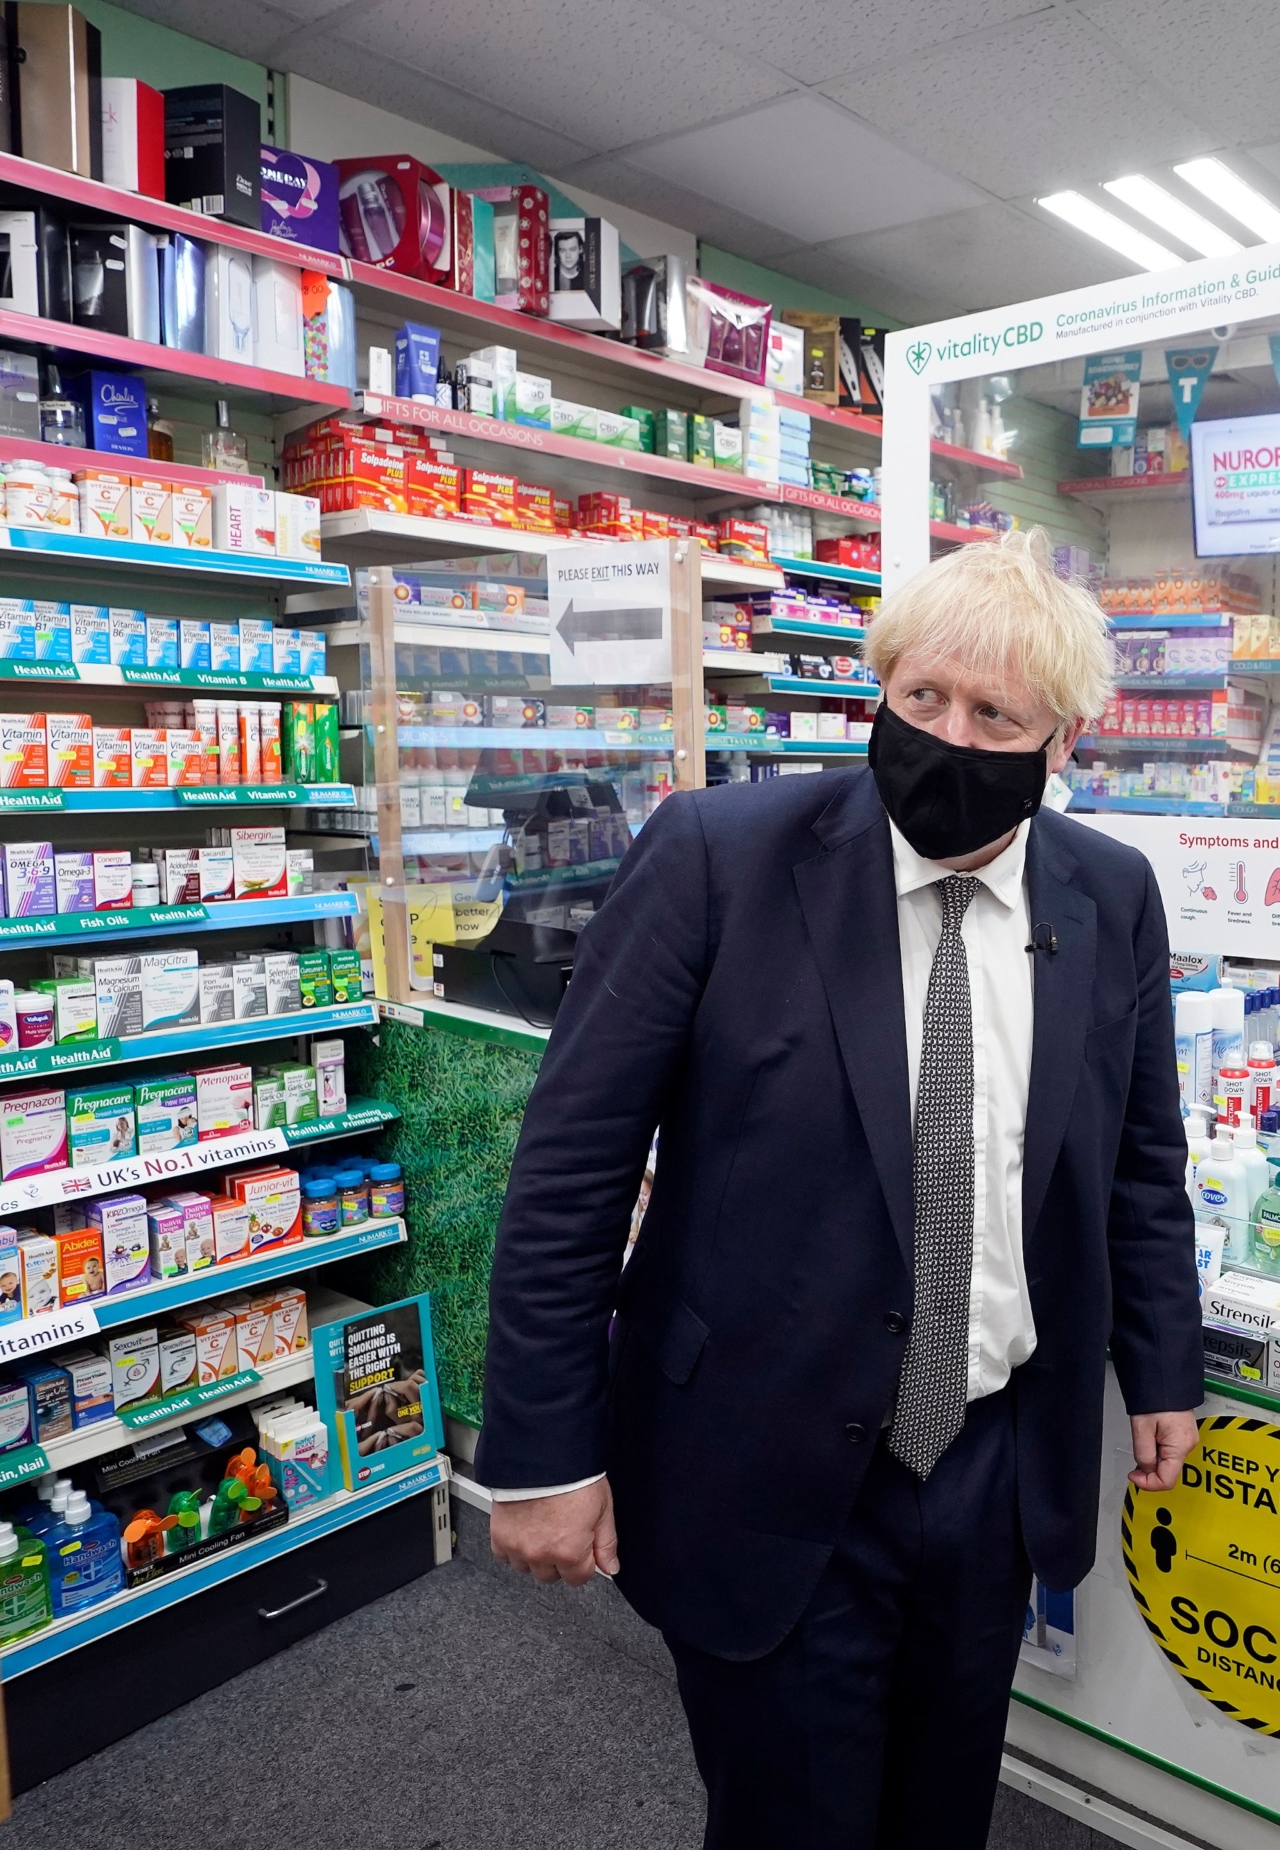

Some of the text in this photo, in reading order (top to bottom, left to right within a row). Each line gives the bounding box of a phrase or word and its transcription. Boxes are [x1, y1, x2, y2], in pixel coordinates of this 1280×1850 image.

[1056, 301, 1137, 327] Coronavirus
[1142, 278, 1225, 309] Information
[1230, 273, 1240, 288] &
[1056, 287, 1259, 340] Manufactured in conjunction with Vitality CBD.
[100, 383, 138, 406] Charlie
[1178, 377, 1198, 403] T
[372, 396, 544, 447] IFTS FOR ALL OCCASIONS
[552, 409, 574, 423] CBD
[360, 452, 404, 471] Solpadeine
[386, 467, 404, 480] PLUS
[1214, 489, 1245, 500] 400mg
[1246, 489, 1270, 499] LIQUID
[229, 505, 242, 548] HEART
[558, 562, 660, 582] PLEASE EXIT THIS WAY
[13, 664, 75, 678] HealthAid
[125, 669, 247, 686] HealthAid Vitamin B
[182, 789, 297, 801] HealthAid Vitamin D
[236, 830, 272, 843] Sibergin
[1179, 833, 1250, 851] Symptoms
[1252, 835, 1279, 850] and
[10, 859, 46, 869] OMEGA
[58, 867, 91, 878] Omega-3
[1180, 907, 1208, 915] Continuous
[80, 915, 129, 928] Fish Oils
[143, 955, 189, 969] MagCitra
[1170, 953, 1203, 965] Maalox
[98, 976, 140, 987] Magnesium
[113, 984, 140, 993] Calcium
[50, 1048, 112, 1066] HealthAid
[200, 1072, 250, 1088] Menopace
[3, 1096, 62, 1114] Pregnazon
[72, 1094, 132, 1115] Pregnacare
[342, 1111, 393, 1129] Primrose Oil
[347, 1109, 382, 1121] Evening
[287, 1123, 336, 1138] HealthAid
[97, 1139, 277, 1187] UK's No.1 vitamins
[1201, 1191, 1228, 1203] covex
[63, 1237, 99, 1252] Abidec
[348, 1323, 386, 1345] QUITTING
[348, 1333, 396, 1357] SMOKING IS
[349, 1342, 401, 1370] EASIER WITH
[350, 1357, 392, 1381] THE RIGHT
[350, 1368, 395, 1392] SUPPORT
[133, 1396, 190, 1425] HealthAid
[1201, 1445, 1260, 1476] KEEP
[63, 1539, 117, 1566] Handwash
[179, 1531, 245, 1564] Mini Cooling Fan
[1228, 1543, 1258, 1567] 2m
